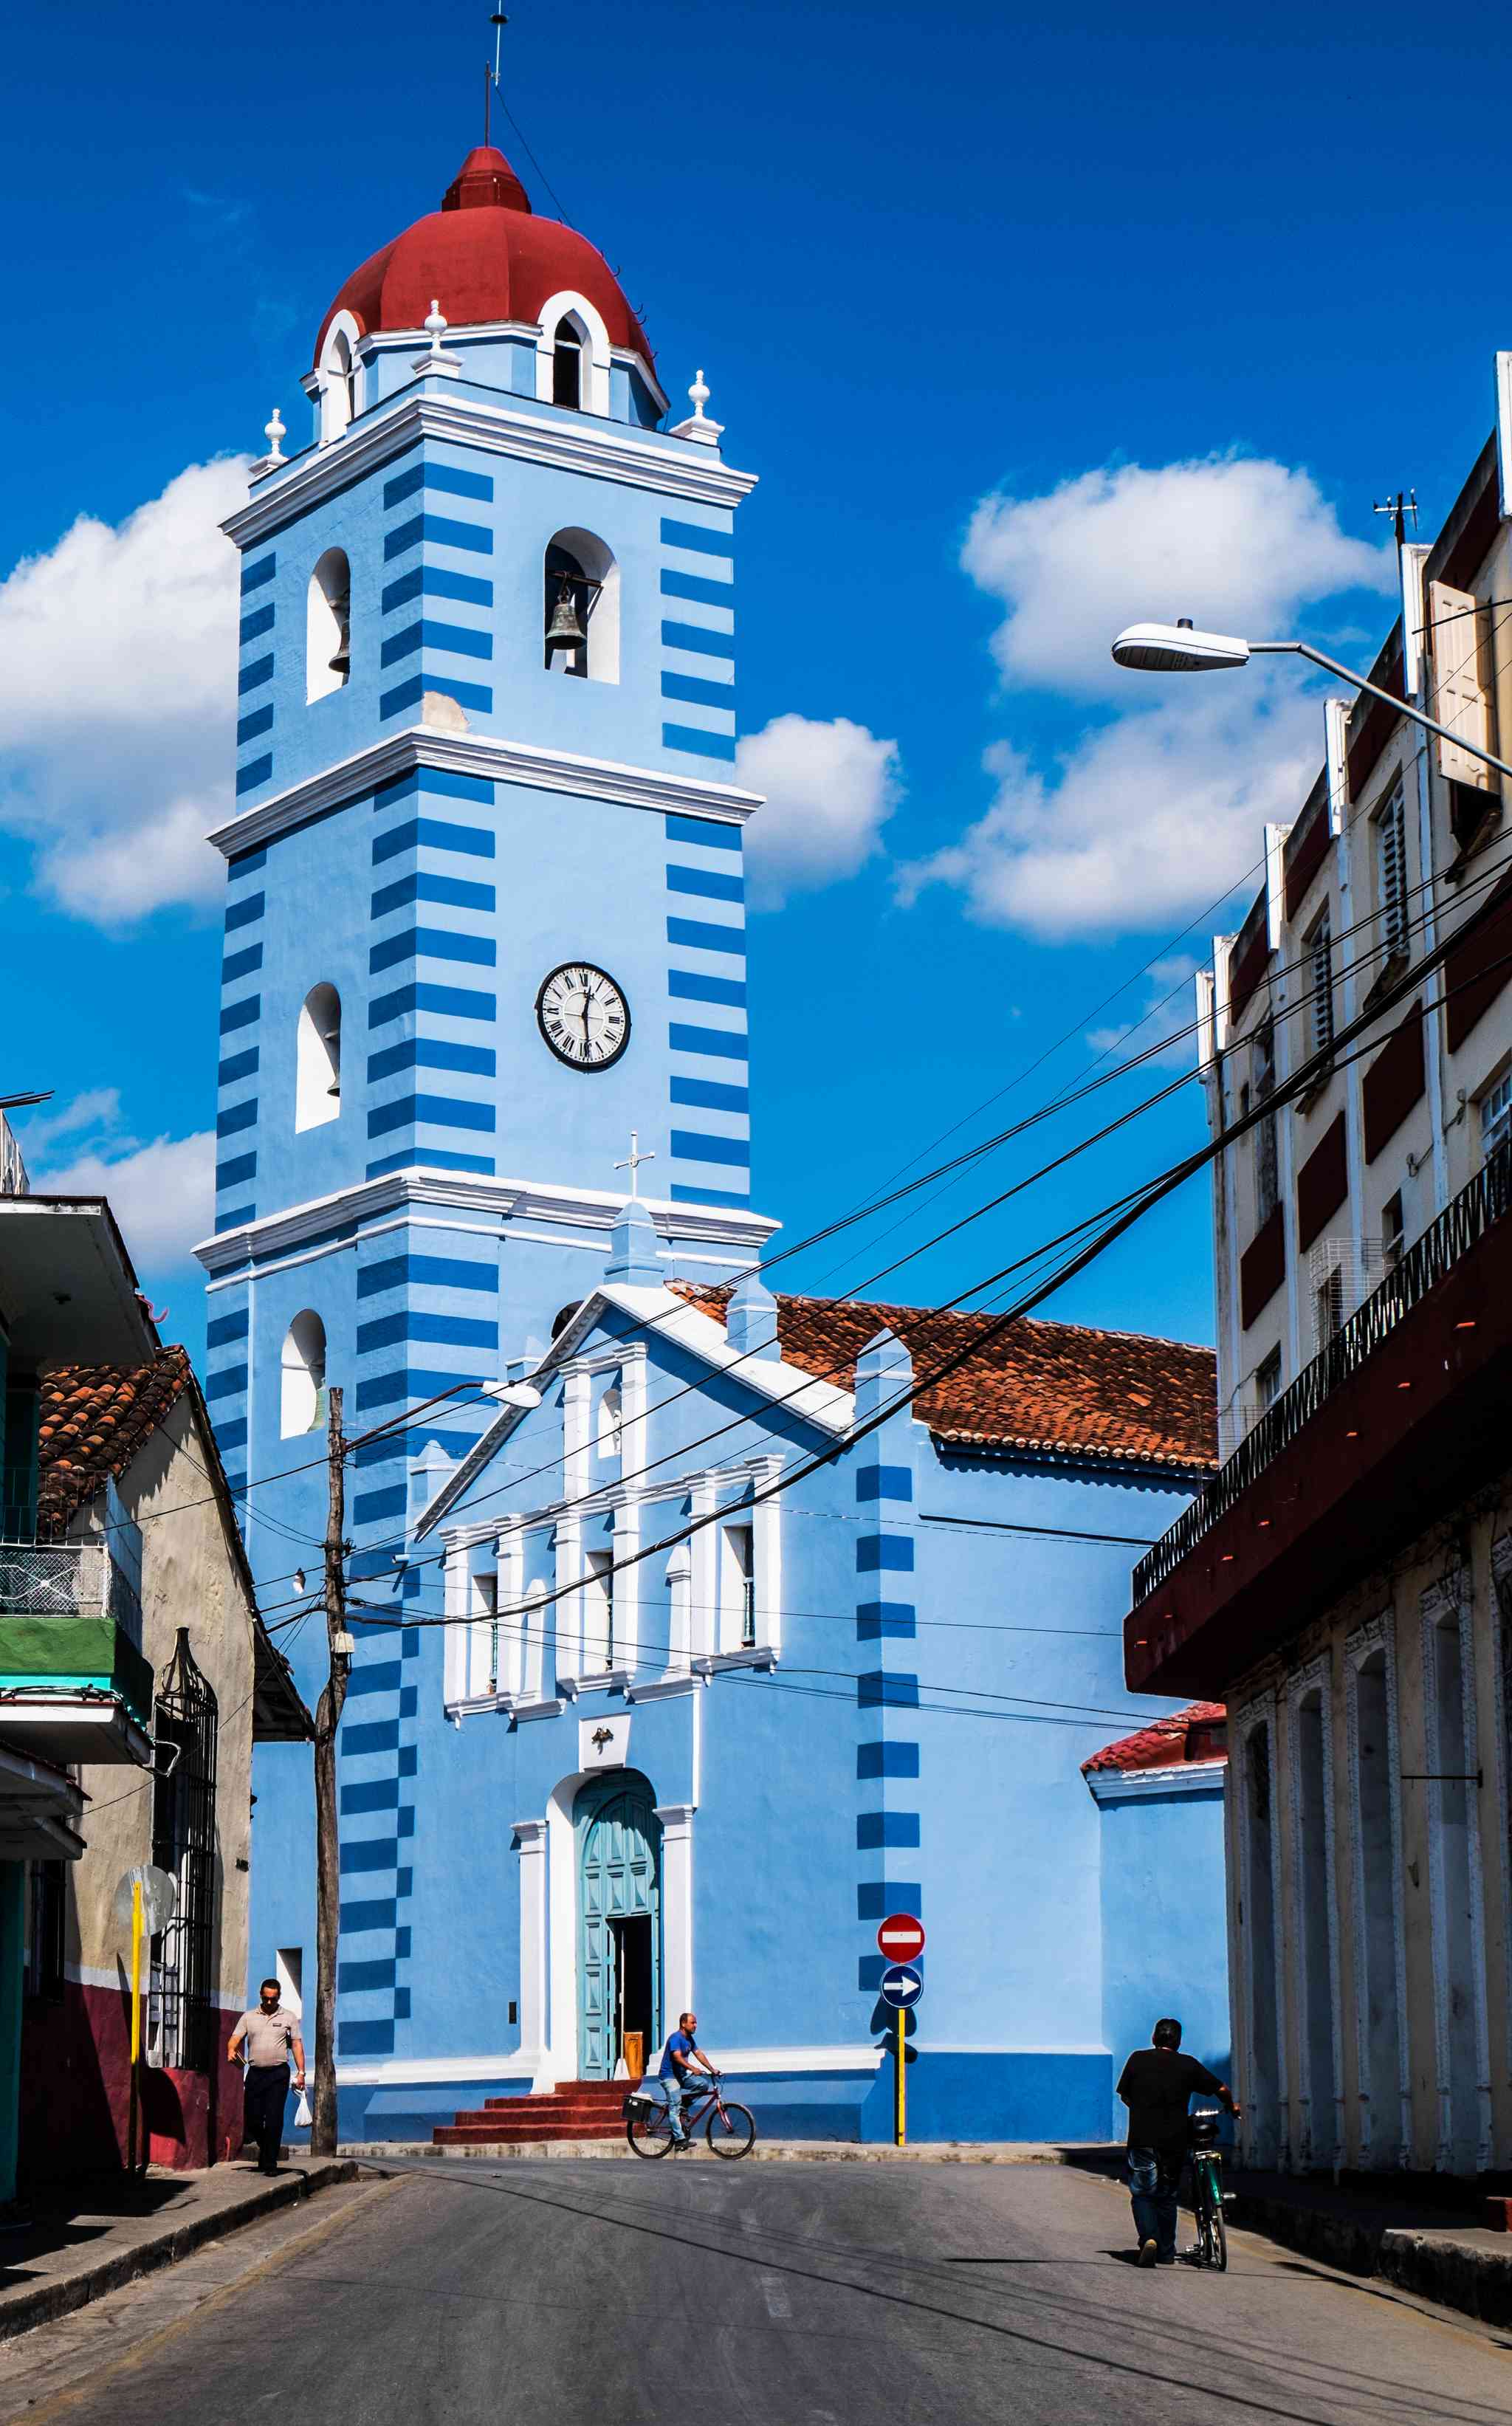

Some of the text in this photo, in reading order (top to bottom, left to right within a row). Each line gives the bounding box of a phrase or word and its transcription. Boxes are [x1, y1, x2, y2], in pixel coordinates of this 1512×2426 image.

[596, 978, 604, 992] I
[604, 997, 616, 1006] II
[608, 1016, 620, 1025] III
